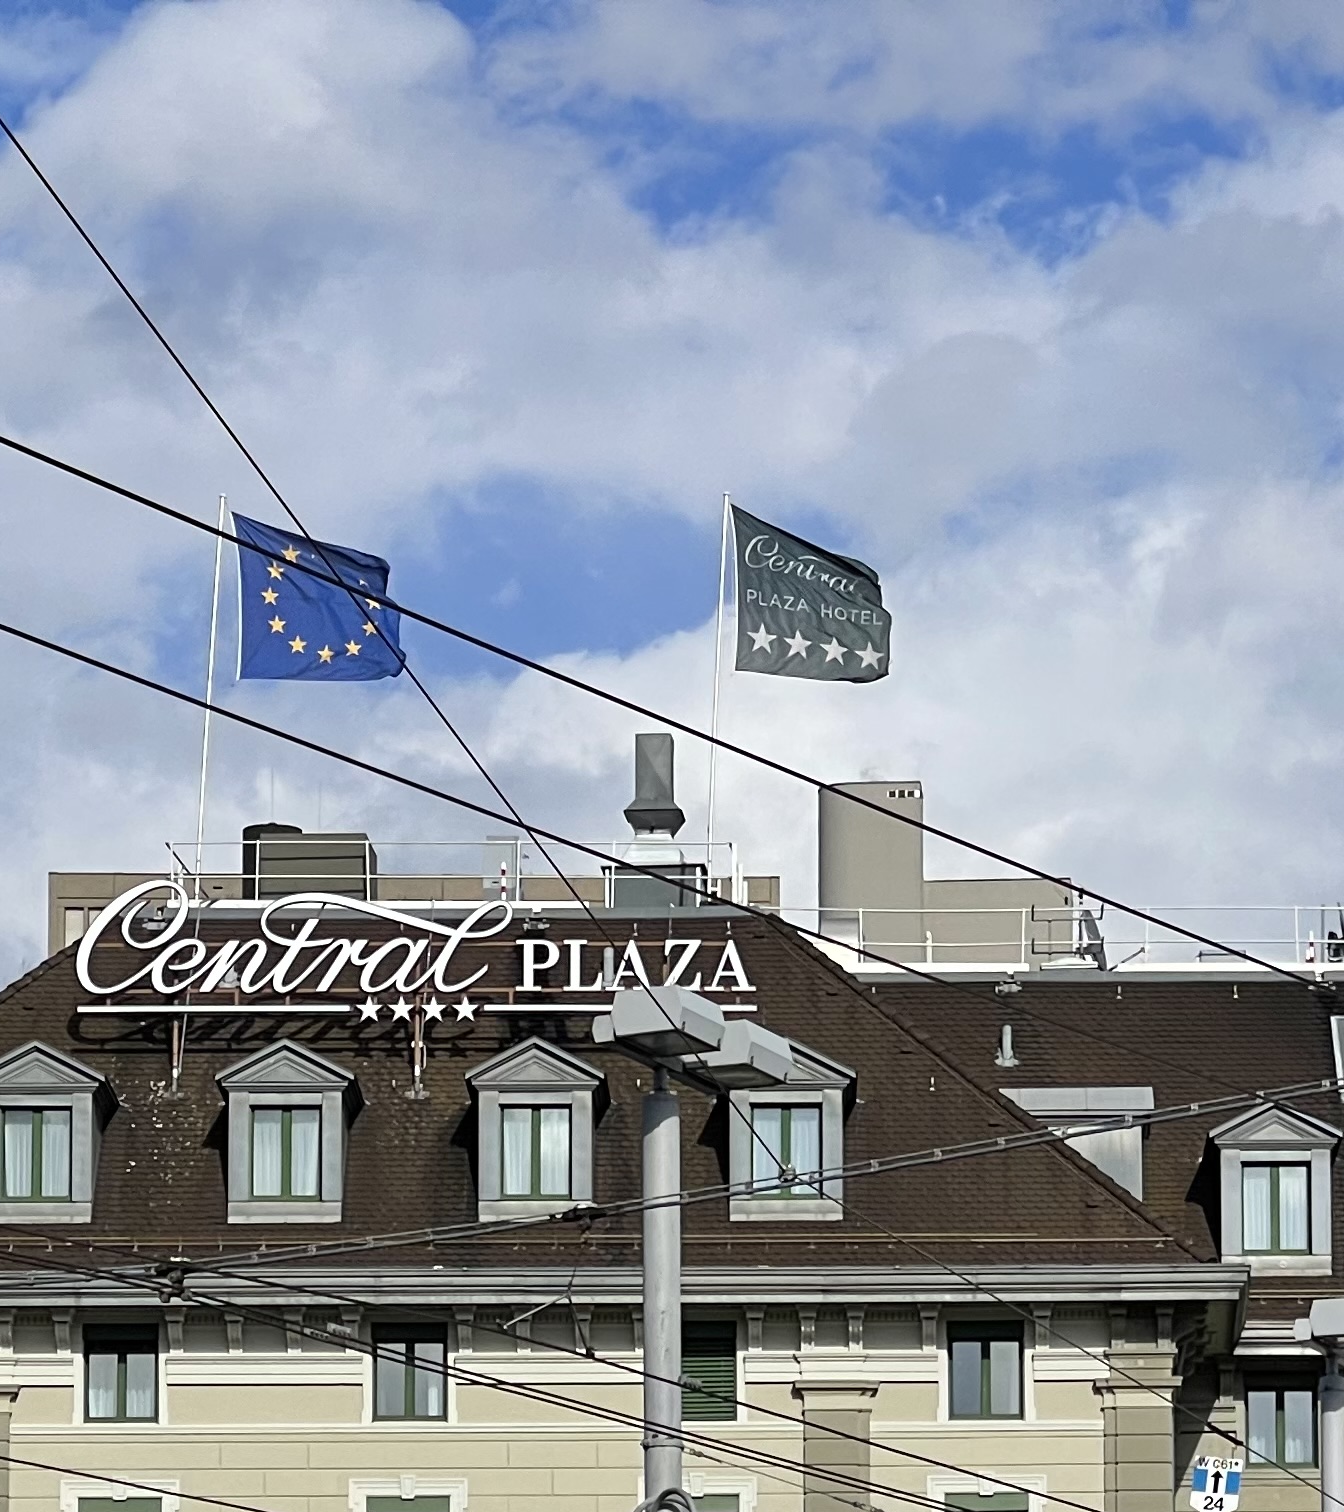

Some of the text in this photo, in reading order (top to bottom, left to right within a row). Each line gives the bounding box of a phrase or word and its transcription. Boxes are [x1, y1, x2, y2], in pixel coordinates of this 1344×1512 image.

[747, 588, 883, 625] PLAZA HOTEL
[76, 880, 756, 996] Central PLAZA
[1203, 1495, 1224, 1512] 24
